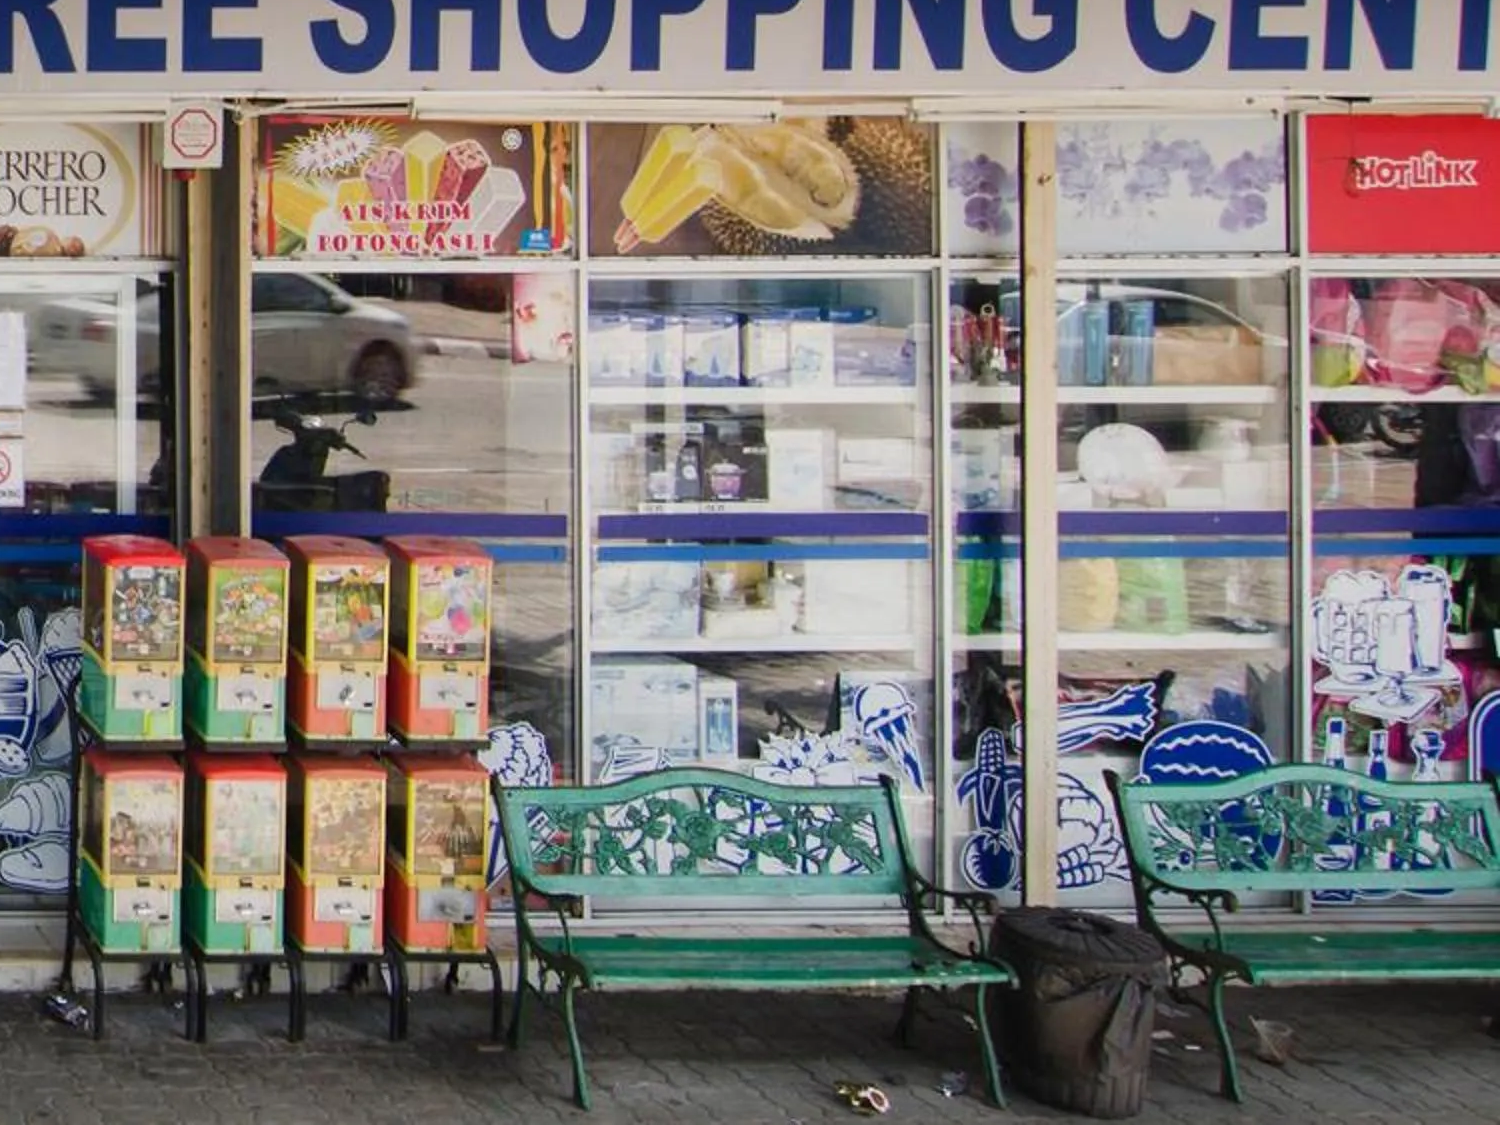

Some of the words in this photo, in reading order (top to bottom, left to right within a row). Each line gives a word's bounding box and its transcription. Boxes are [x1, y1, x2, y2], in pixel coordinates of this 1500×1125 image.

[341, 202, 386, 221] AIS
[393, 202, 472, 221] KRIM
[317, 233, 420, 252] POTONG
